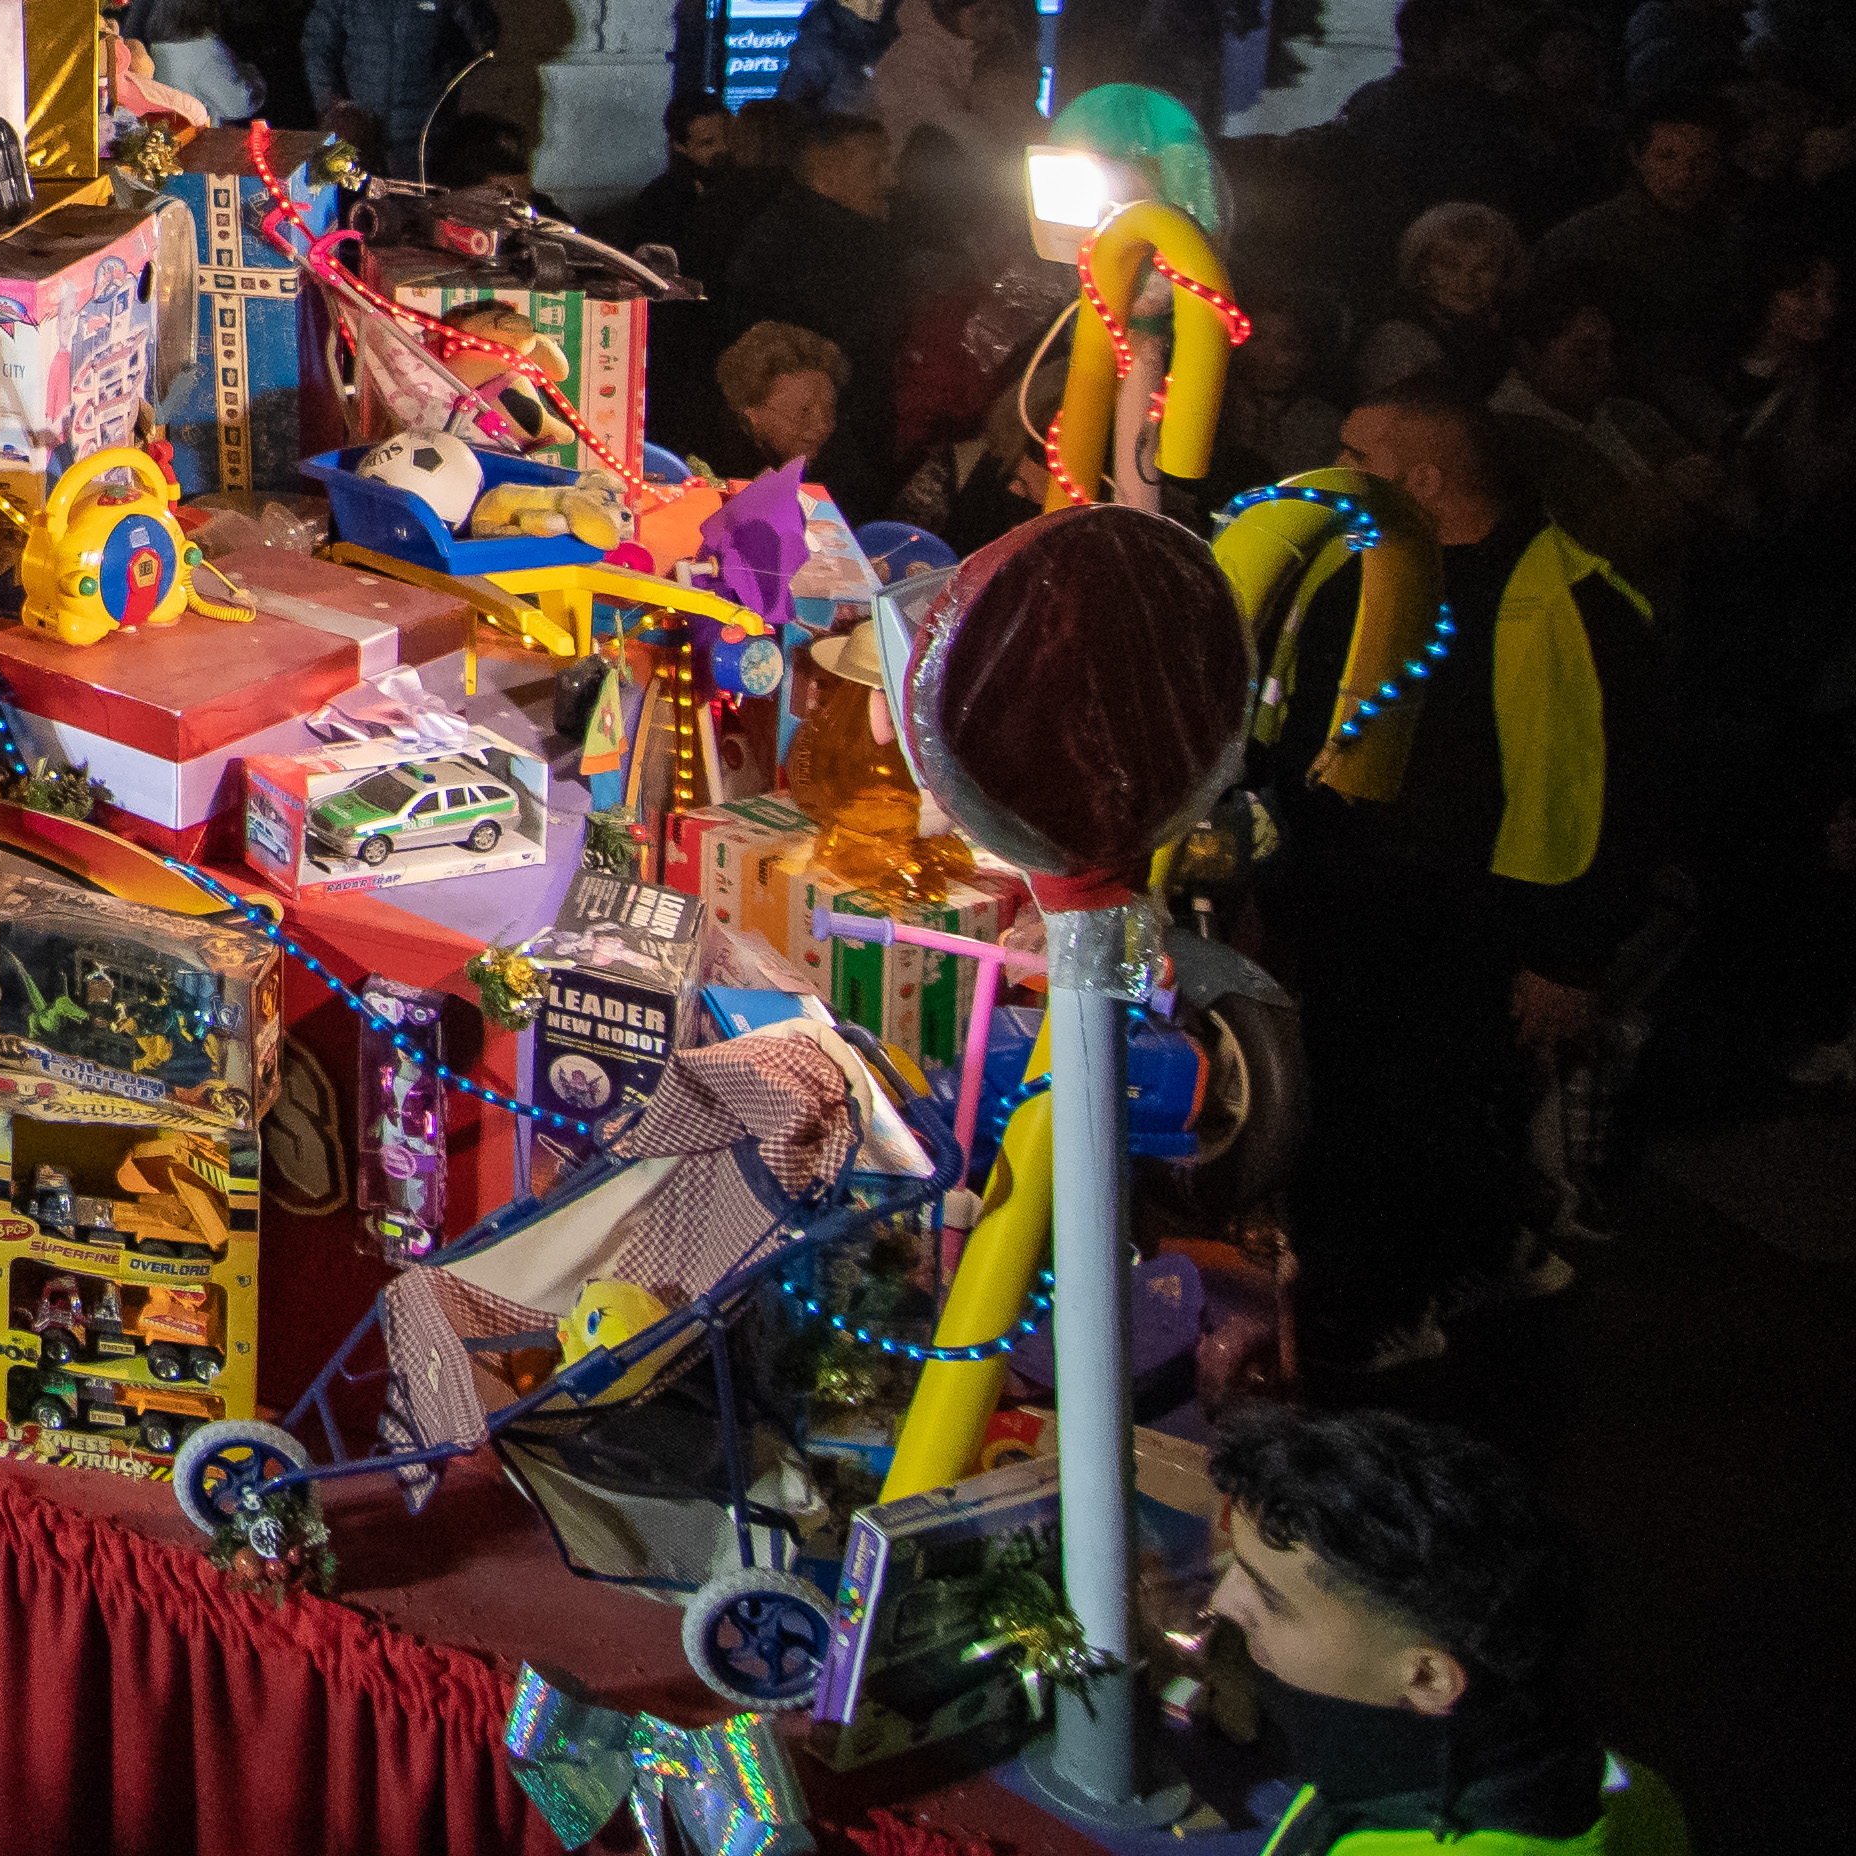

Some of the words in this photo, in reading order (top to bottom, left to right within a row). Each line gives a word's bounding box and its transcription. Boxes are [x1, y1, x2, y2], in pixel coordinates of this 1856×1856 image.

[2, 363, 26, 379] CITY
[326, 878, 368, 892] RADAR
[549, 985, 665, 1033] LEADER
[547, 1011, 591, 1035] NEW
[596, 1024, 665, 1054] ROBOT
[29, 1241, 120, 1264] SUPERFINE
[129, 1258, 210, 1277] OVERLOAD
